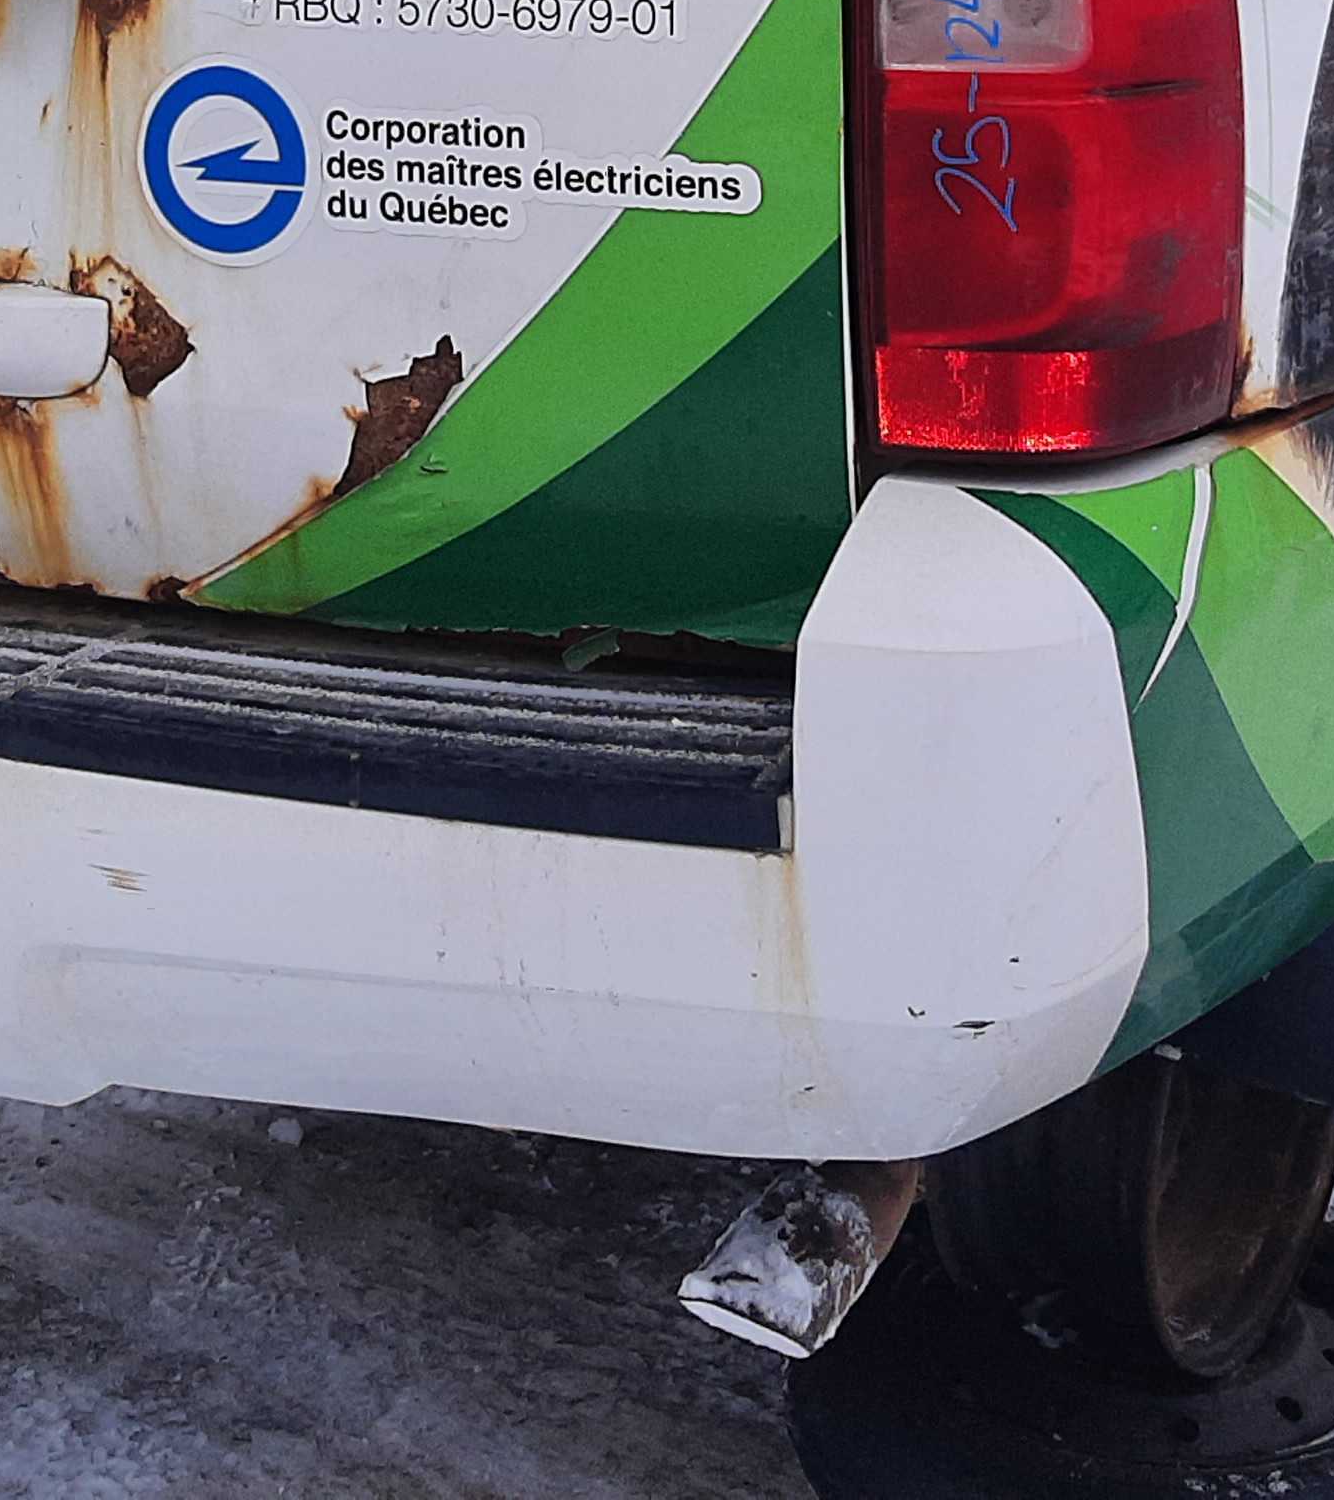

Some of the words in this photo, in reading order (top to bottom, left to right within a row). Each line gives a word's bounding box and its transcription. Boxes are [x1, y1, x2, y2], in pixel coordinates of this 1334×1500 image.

[326, 109, 526, 149] Corporation
[326, 150, 385, 182] des
[396, 155, 523, 190] maîtres
[532, 162, 743, 201] électriciens
[327, 189, 370, 221] du
[379, 193, 510, 231] Québec
